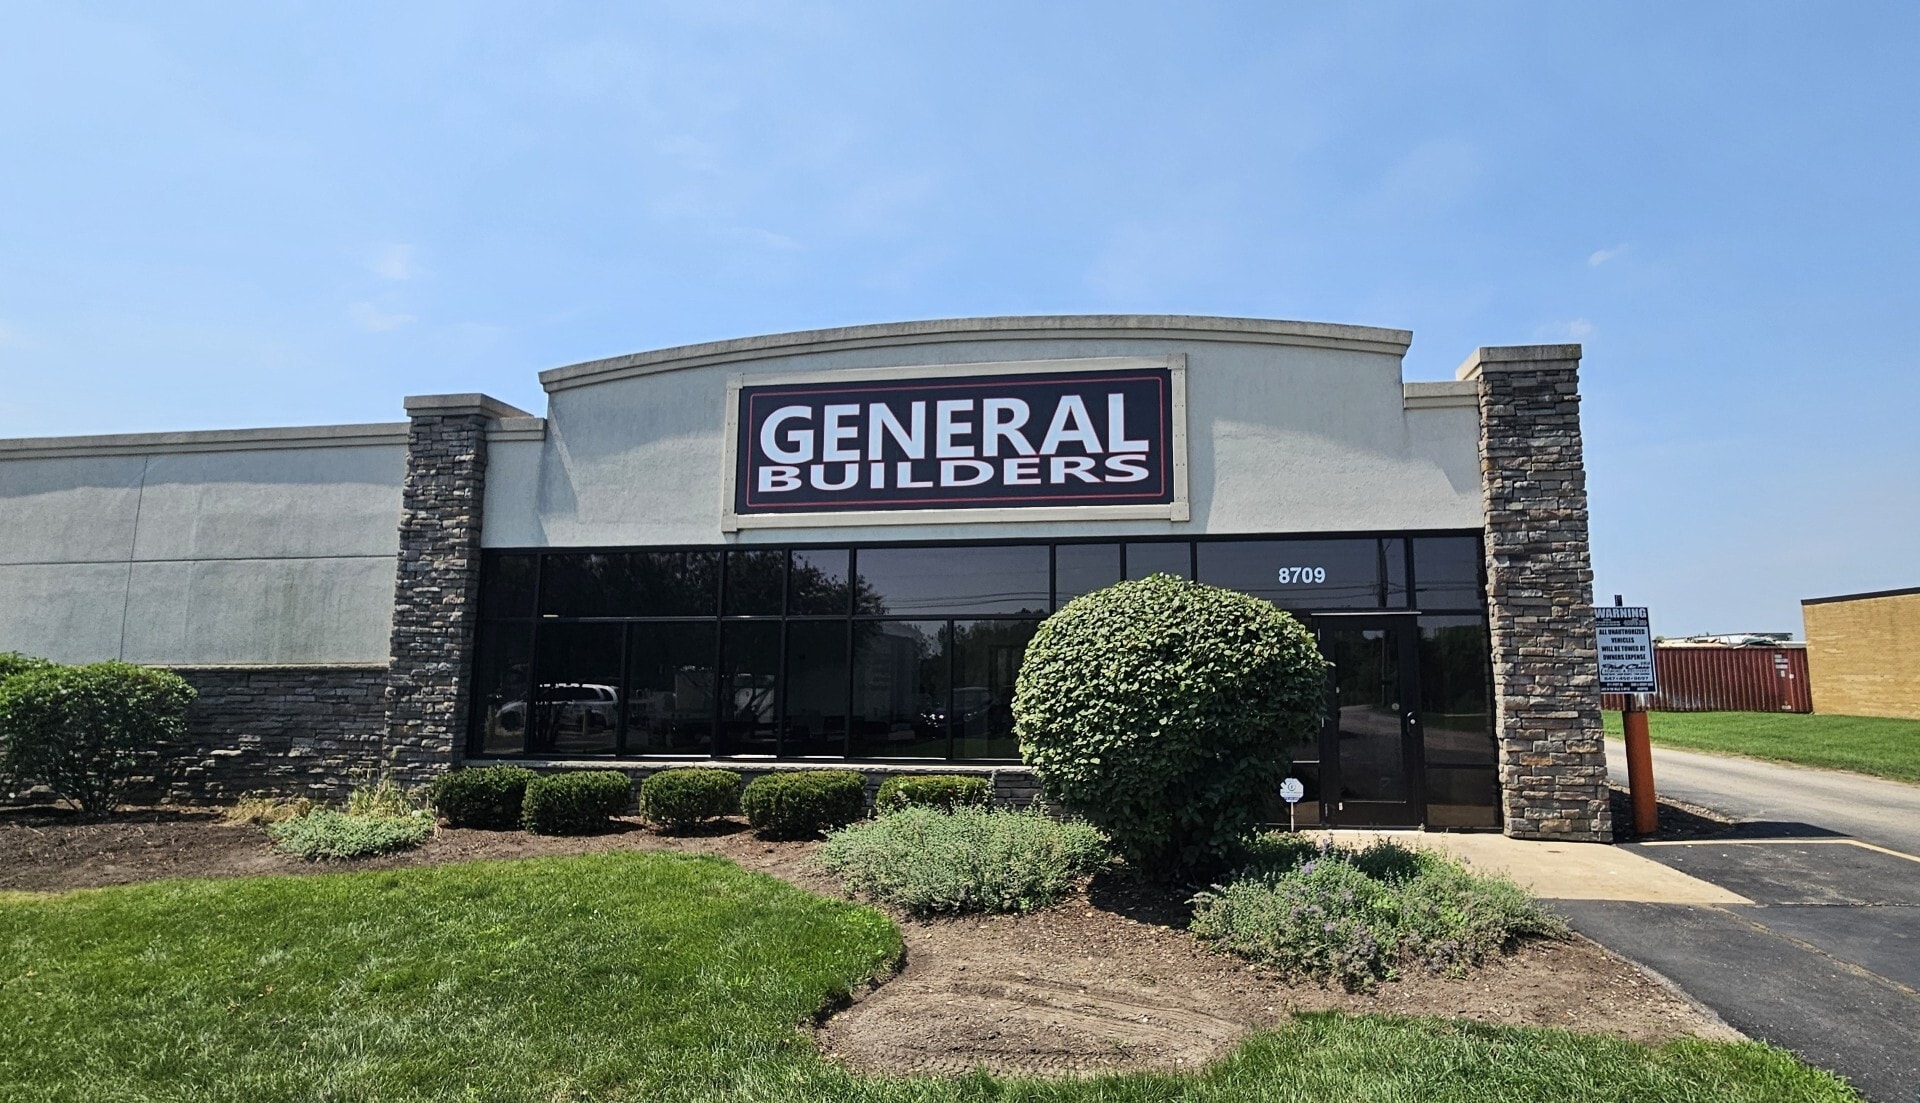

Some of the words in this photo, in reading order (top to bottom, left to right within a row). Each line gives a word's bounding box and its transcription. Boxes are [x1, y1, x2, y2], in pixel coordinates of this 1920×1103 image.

[759, 393, 1149, 464] GENERAL
[757, 454, 1150, 492] BUILDERS
[1279, 567, 1326, 584] 8709
[1595, 608, 1647, 618] WARNING
